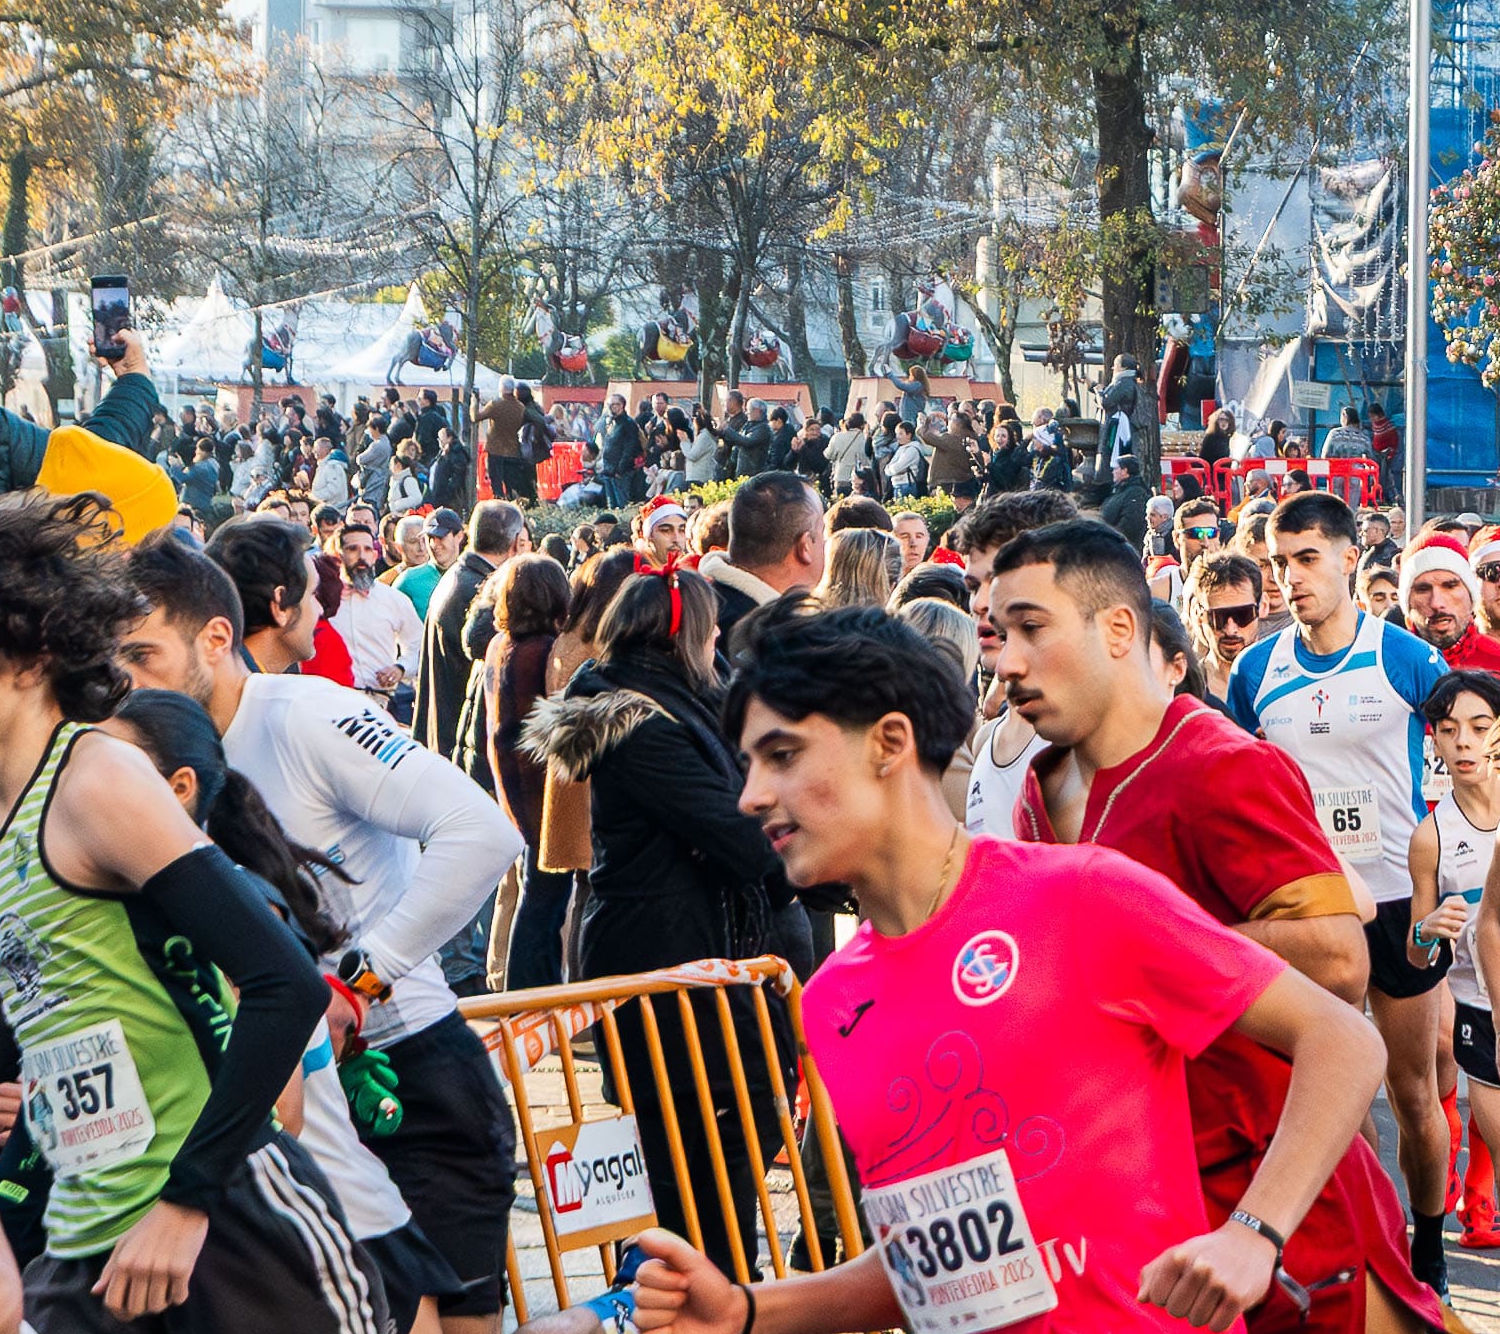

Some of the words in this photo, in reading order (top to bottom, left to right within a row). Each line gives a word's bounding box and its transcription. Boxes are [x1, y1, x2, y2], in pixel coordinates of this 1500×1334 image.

[1327, 789, 1373, 806] SILVESTRE
[1332, 807, 1362, 833] 65
[1361, 831, 1378, 843] 2025
[50, 1028, 121, 1073] SILVESTRE
[56, 1061, 116, 1121] 357
[116, 1106, 145, 1135] 2025
[909, 1160, 1005, 1219] SILVESTRE
[905, 1198, 1025, 1279] 3802
[926, 1273, 999, 1308] PONTEVEDRA
[1001, 1255, 1035, 1286] 2025
